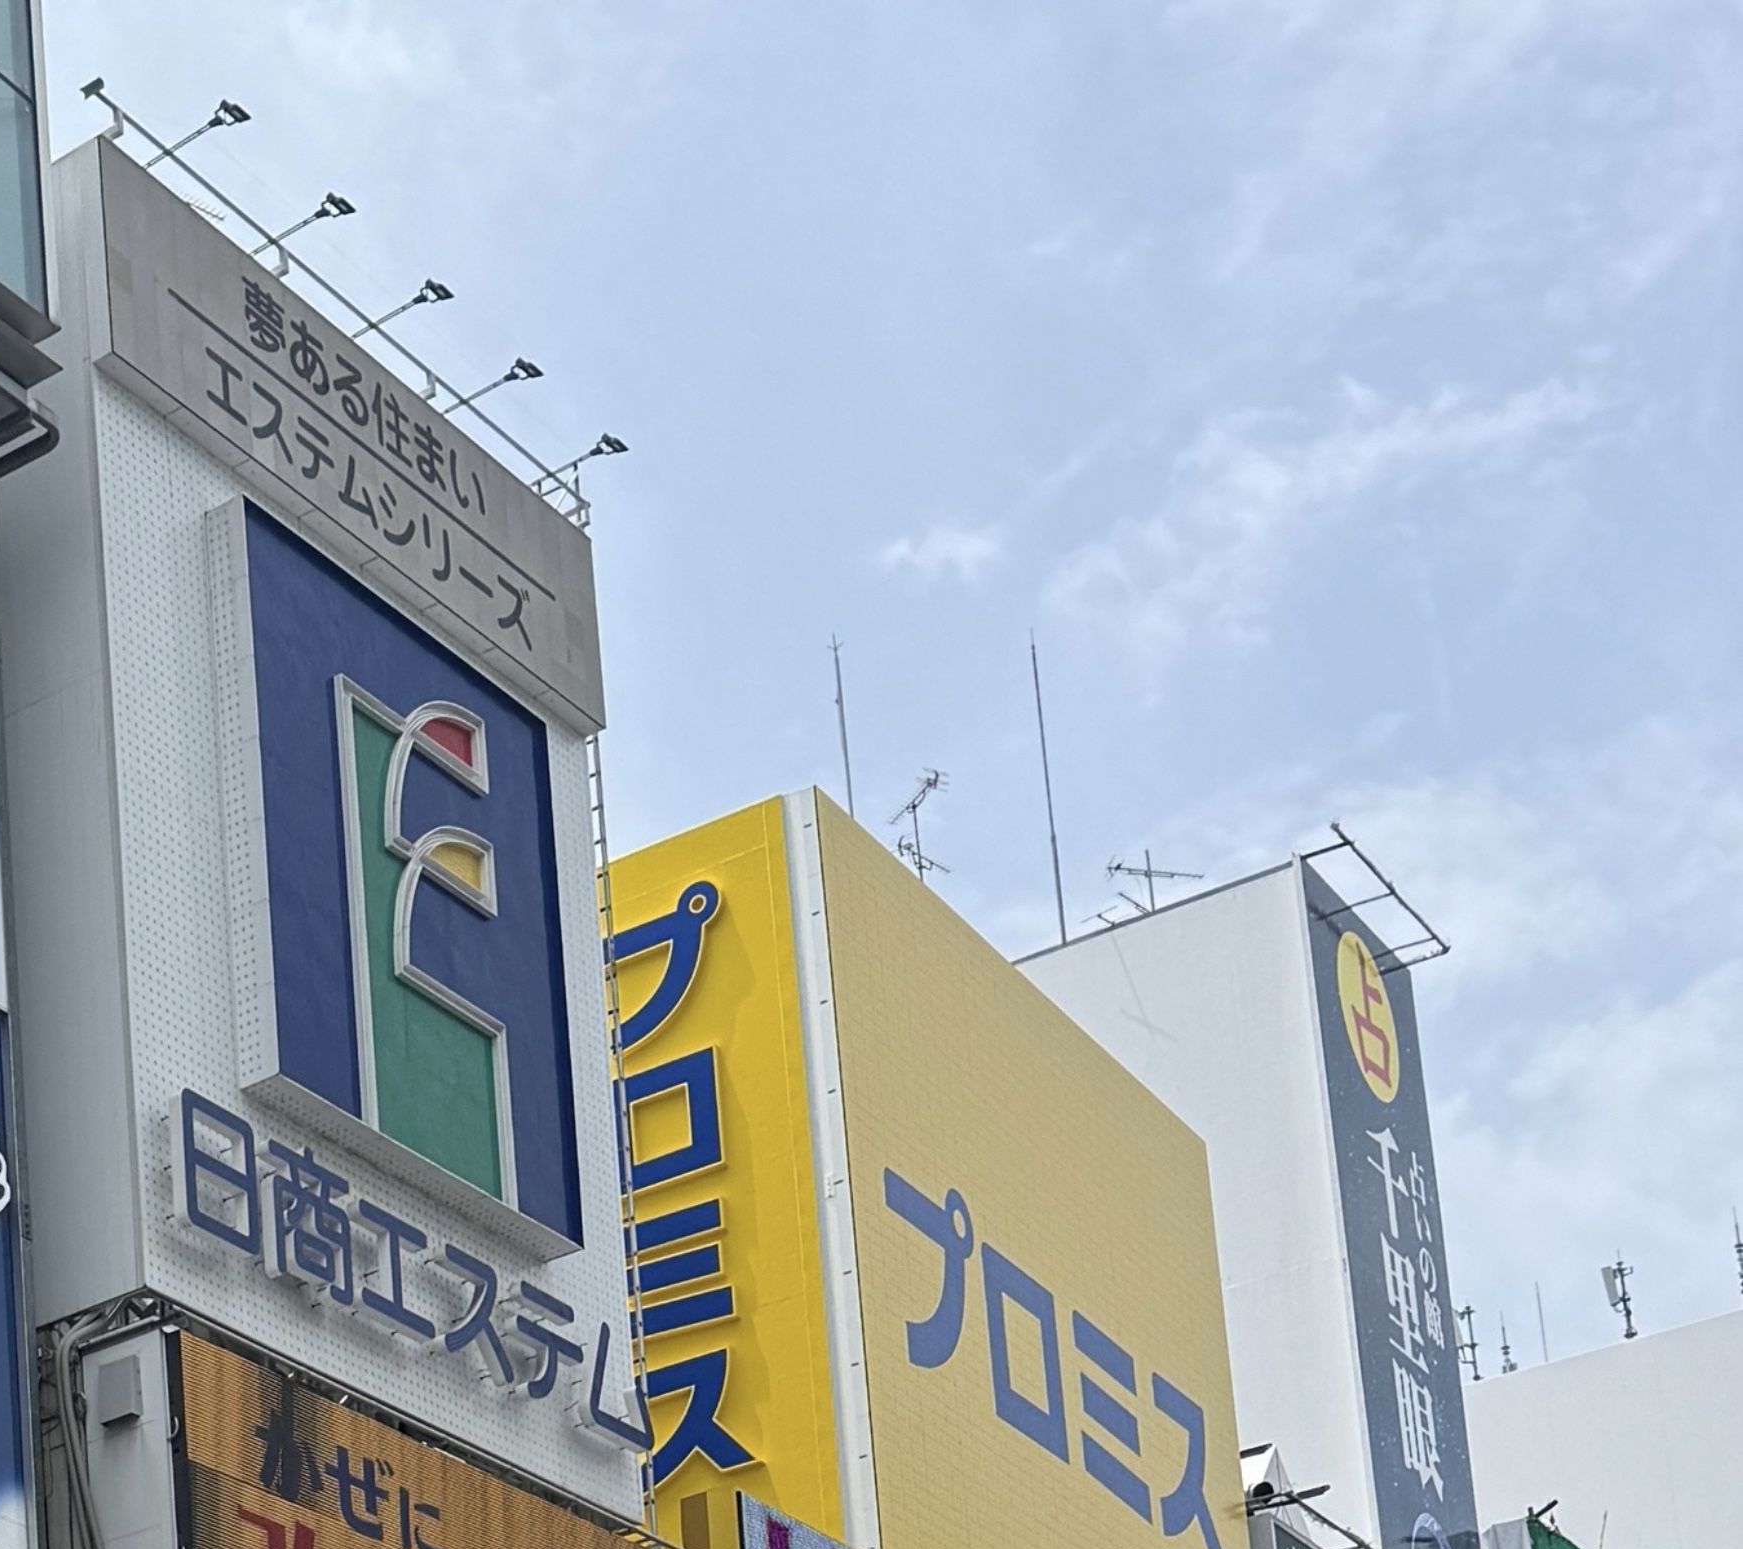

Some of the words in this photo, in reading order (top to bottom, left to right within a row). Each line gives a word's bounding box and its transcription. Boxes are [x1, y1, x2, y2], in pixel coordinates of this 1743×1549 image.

[204, 346, 533, 651] エステムシリーズ
[241, 275, 486, 516] 夢ある住まい
[1356, 942, 1392, 1090] 占
[182, 1088, 654, 1451] 日商エステム
[604, 881, 762, 1496] プロミス
[1365, 1127, 1444, 1503] 千里眼
[1410, 1151, 1445, 1350] 占いの館
